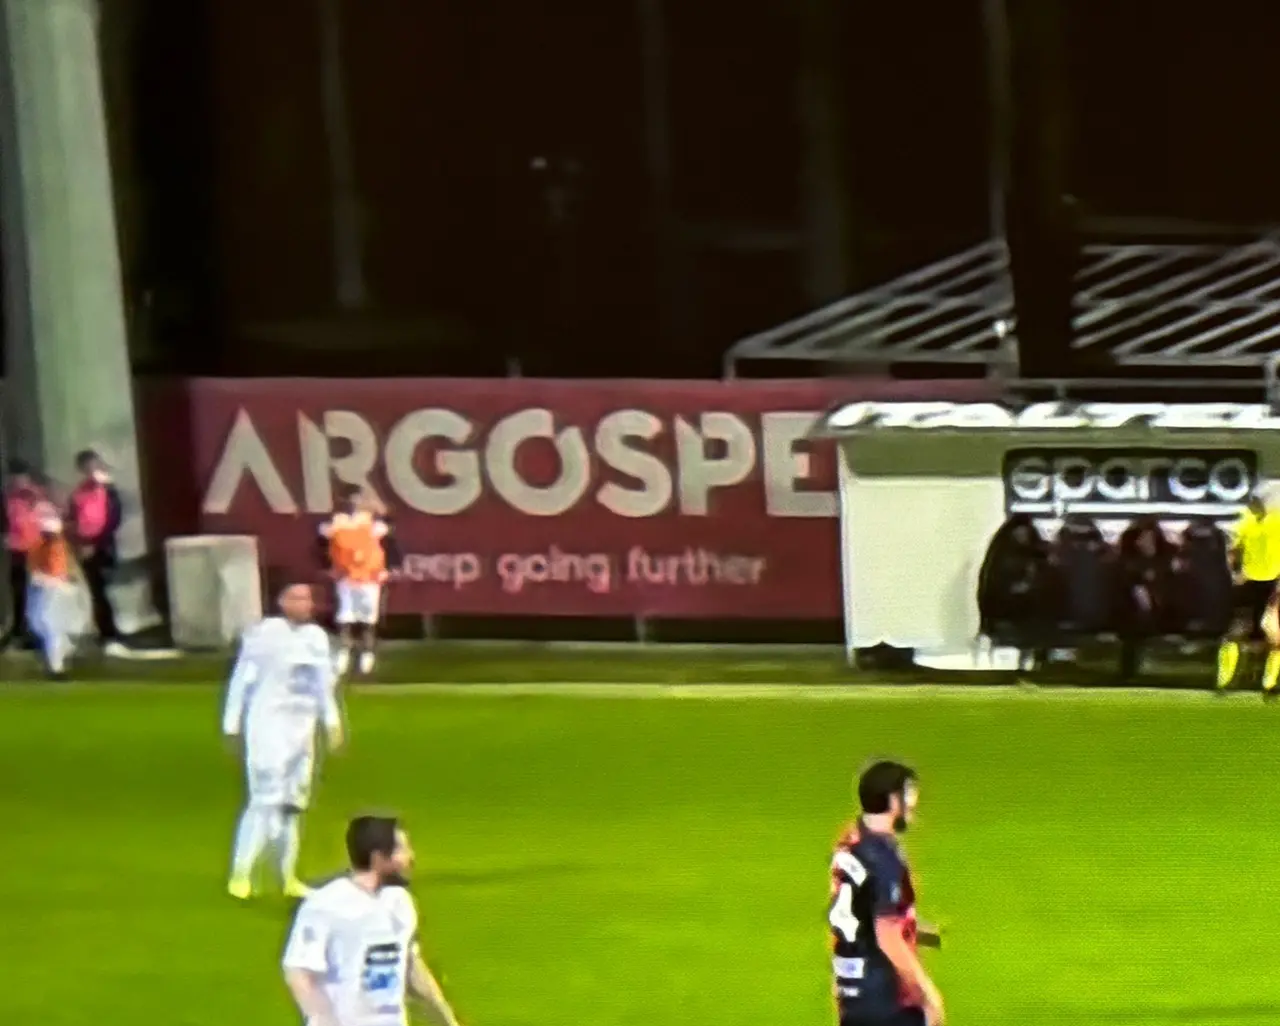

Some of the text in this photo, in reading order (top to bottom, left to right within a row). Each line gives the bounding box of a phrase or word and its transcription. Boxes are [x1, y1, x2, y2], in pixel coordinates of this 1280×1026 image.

[204, 407, 842, 517] ARGOSPE
[1011, 456, 1250, 517] sparco
[392, 543, 768, 594] eep going further
